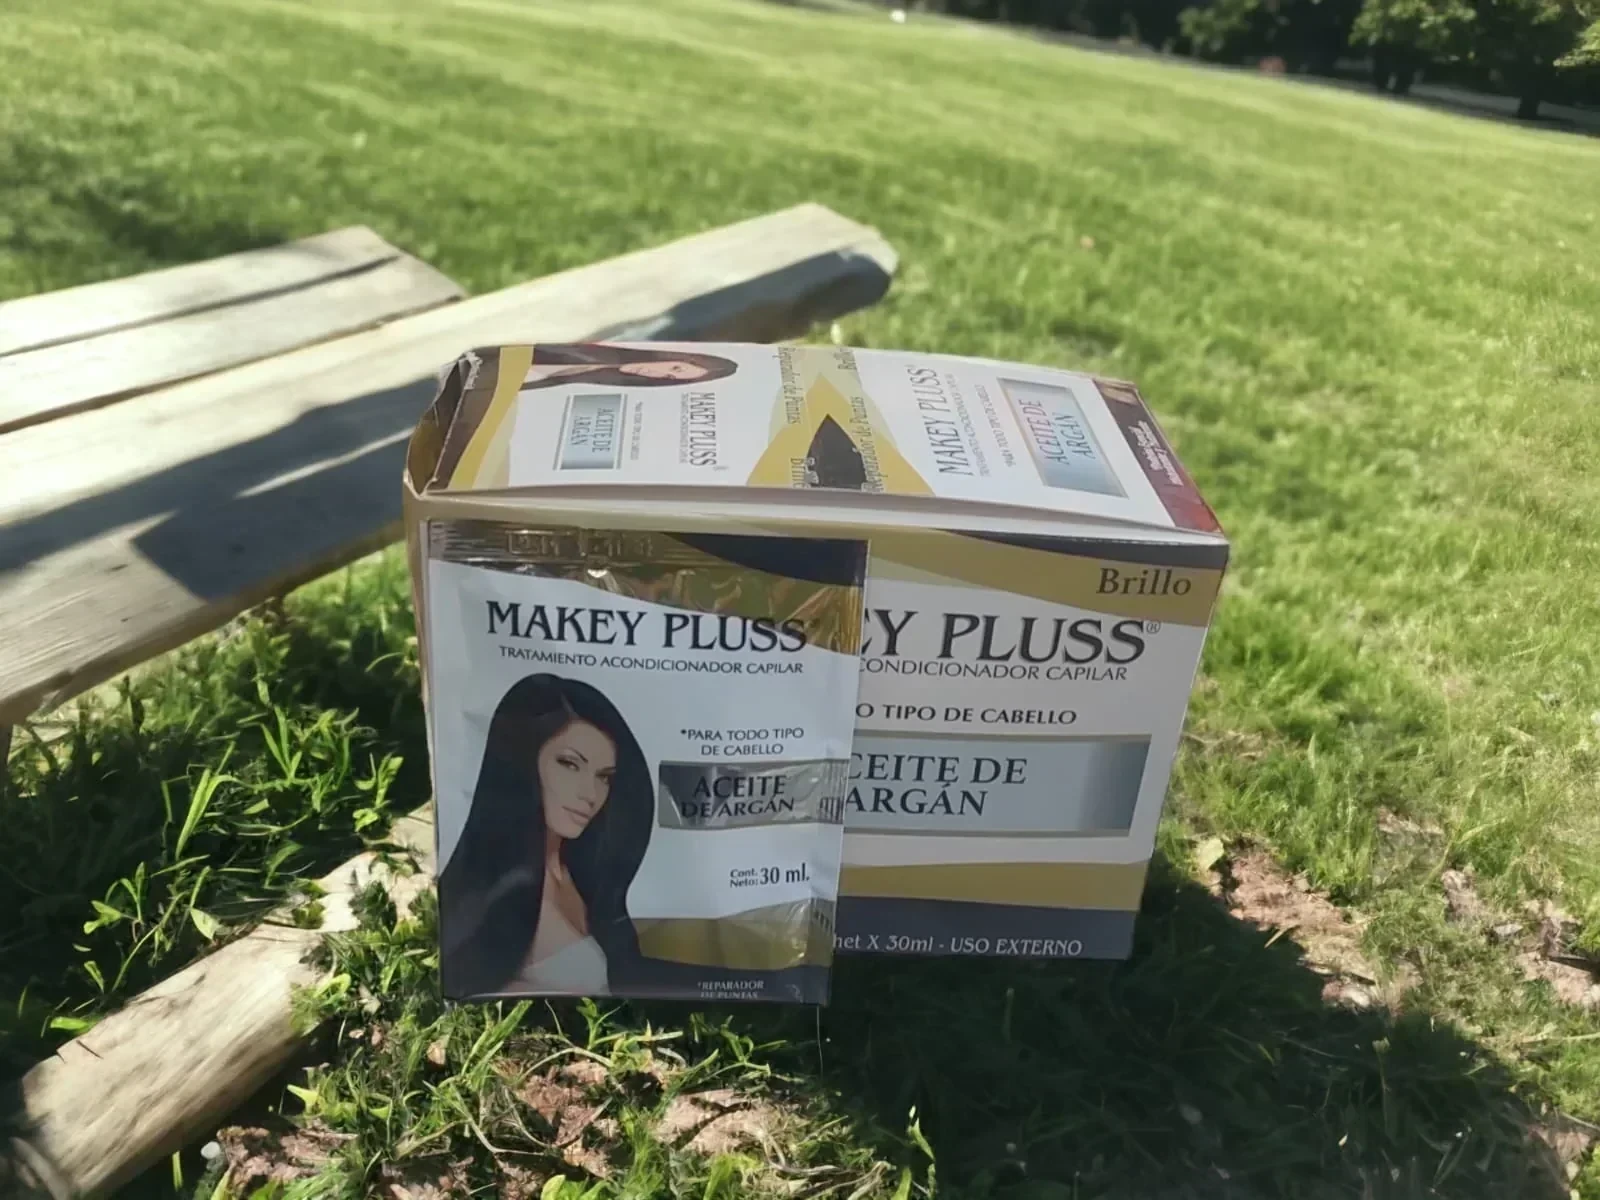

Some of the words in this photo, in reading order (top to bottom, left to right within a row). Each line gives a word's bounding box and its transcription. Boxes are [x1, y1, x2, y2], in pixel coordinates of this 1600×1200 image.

[689, 391, 717, 430] MAKEY
[1018, 398, 1048, 417] DE
[592, 407, 614, 438] ACEITE
[592, 440, 612, 453] DE
[921, 414, 975, 477] MAKEY
[1025, 417, 1070, 466] ACEITE
[1096, 566, 1192, 597] Brillo
[486, 600, 648, 647] MAKEY
[662, 612, 807, 653] PLUSS
[499, 646, 597, 667] TRATAMIENTO
[600, 656, 742, 674] ACONDICIONADOR
[747, 661, 804, 674] CAPILAR
[1046, 666, 1129, 682] CAPILAR
[882, 704, 936, 721] TIPO
[943, 706, 974, 723] DE
[980, 708, 1077, 725] CABELLO
[727, 729, 769, 741] TODO
[772, 728, 804, 740] TIPO
[701, 744, 720, 757] DE
[723, 743, 784, 757] CABELLO
[970, 756, 1029, 785] DE
[693, 775, 788, 799] ACEITE
[681, 801, 712, 819] DE
[845, 781, 989, 817] ARGÁN
[730, 867, 758, 879] Cont.
[760, 867, 781, 885] 30
[785, 863, 810, 883] ml.
[730, 876, 759, 889] Neto:
[867, 934, 880, 950] X
[886, 934, 934, 952] 30ml
[951, 937, 990, 954] USO
[995, 939, 1083, 956] EXTERNO
